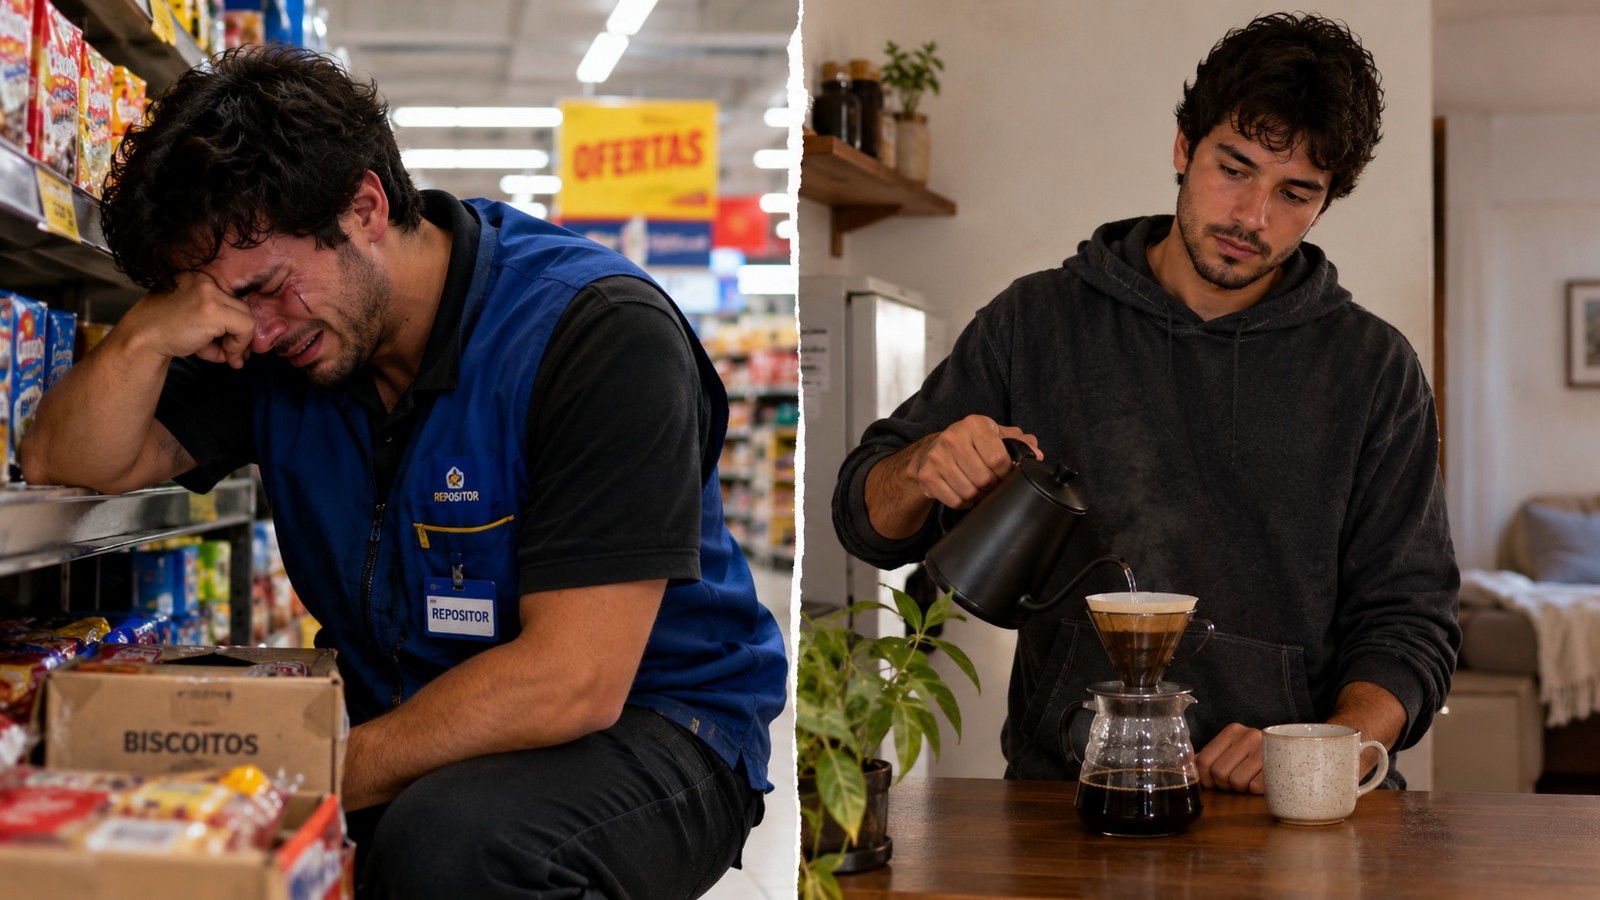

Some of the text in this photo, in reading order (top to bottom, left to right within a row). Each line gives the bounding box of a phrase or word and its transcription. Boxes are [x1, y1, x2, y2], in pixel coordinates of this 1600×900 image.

[573, 129, 704, 180] OFERTAS
[434, 491, 479, 502] REPOSITOR
[432, 607, 489, 623] REPOSITOR
[123, 731, 259, 756] BISCOITOS
